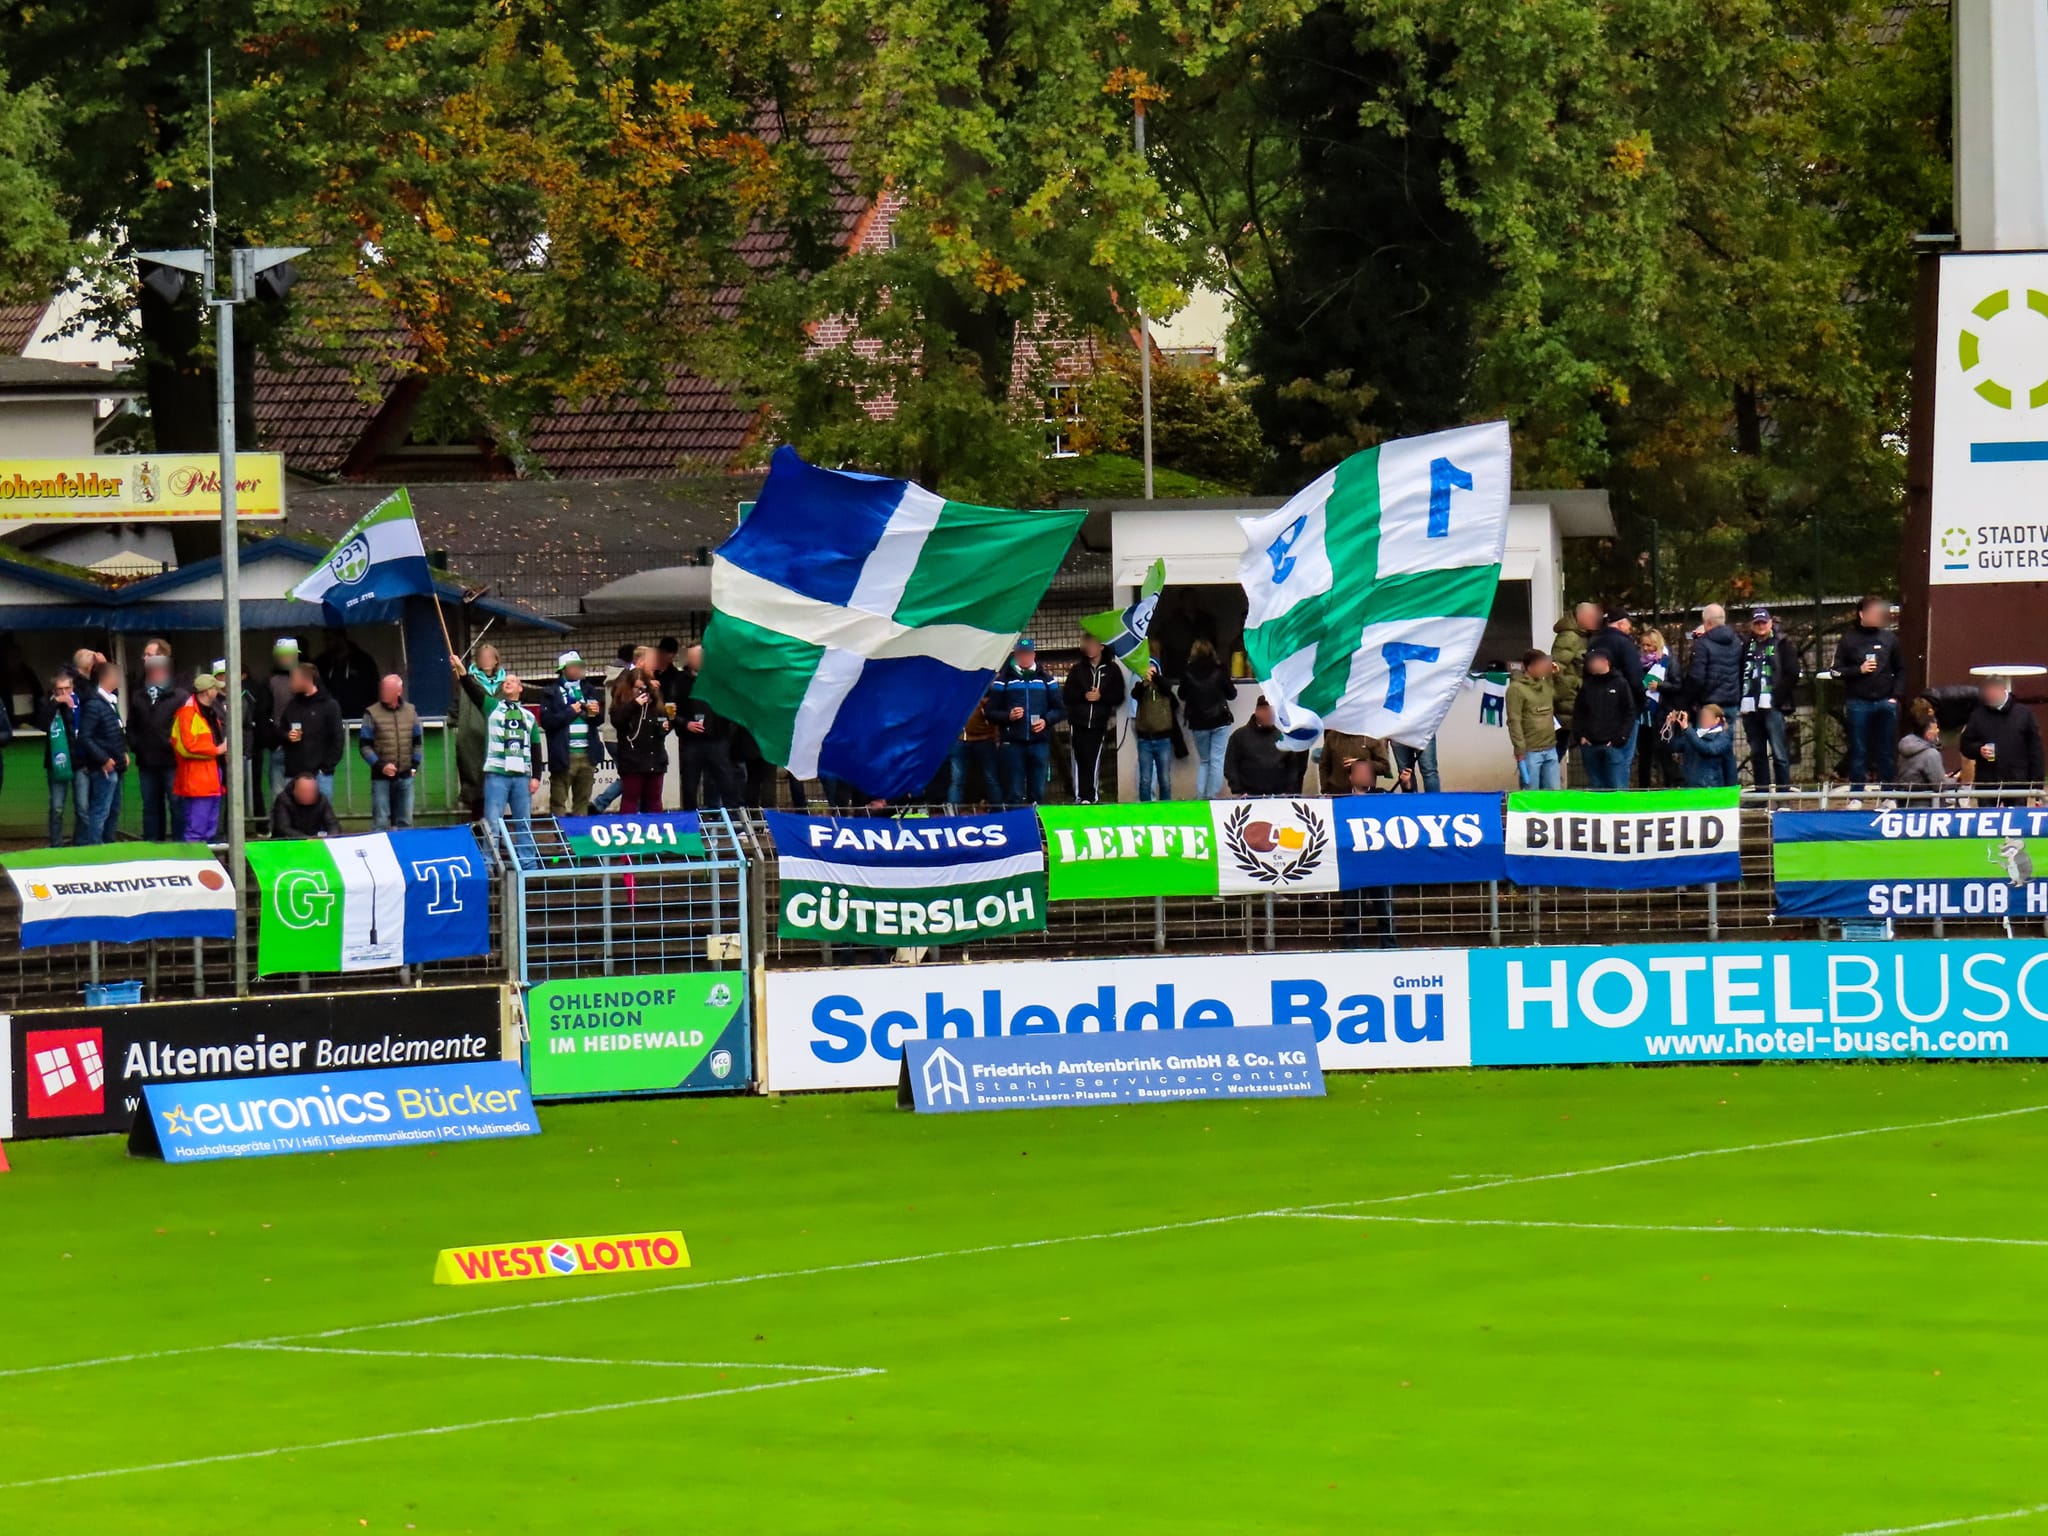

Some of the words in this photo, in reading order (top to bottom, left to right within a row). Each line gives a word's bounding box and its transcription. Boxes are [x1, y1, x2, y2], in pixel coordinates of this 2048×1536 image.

[0, 472, 123, 499] ohenfelder
[591, 822, 677, 847] 05241
[808, 824, 1008, 851] FANATICS
[1054, 825, 1210, 863] LEFFE
[1346, 814, 1483, 852] BOYS
[1526, 815, 1724, 855] BIELEFELD
[53, 875, 193, 896] BIERAKTIVISTEN
[274, 869, 335, 930] G
[412, 856, 472, 915] T
[785, 886, 1035, 935] GÜTERSLOH
[1393, 975, 1443, 988] GmbH
[549, 989, 676, 1011] OHLENDORF
[1271, 979, 1444, 1045] Bau
[550, 1011, 642, 1031] STADION
[123, 1033, 307, 1079] Altemeier
[316, 1034, 487, 1067] Bauelemente
[550, 1037, 576, 1054] IM
[584, 1030, 704, 1052] HEIDEWALD
[1645, 1026, 2009, 1056] www.hotel-busch.com
[972, 1060, 1053, 1078] Friedrich
[1057, 1057, 1163, 1075] Amtenbrink
[1166, 1054, 1221, 1070] GmbH
[1226, 1053, 1240, 1067] &
[1243, 1052, 1274, 1066] Co.
[1278, 1050, 1307, 1065] KG
[193, 1085, 391, 1134] euronics
[397, 1084, 521, 1120] Bücker
[175, 1139, 271, 1157] Haushaltsgeräte
[277, 1137, 294, 1149] TV
[329, 1128, 436, 1145] Telekommunikation
[443, 1125, 461, 1138] PC
[468, 1120, 531, 1136] Multimedia
[453, 1246, 547, 1280] WEST
[575, 1237, 679, 1272] LOTTO
